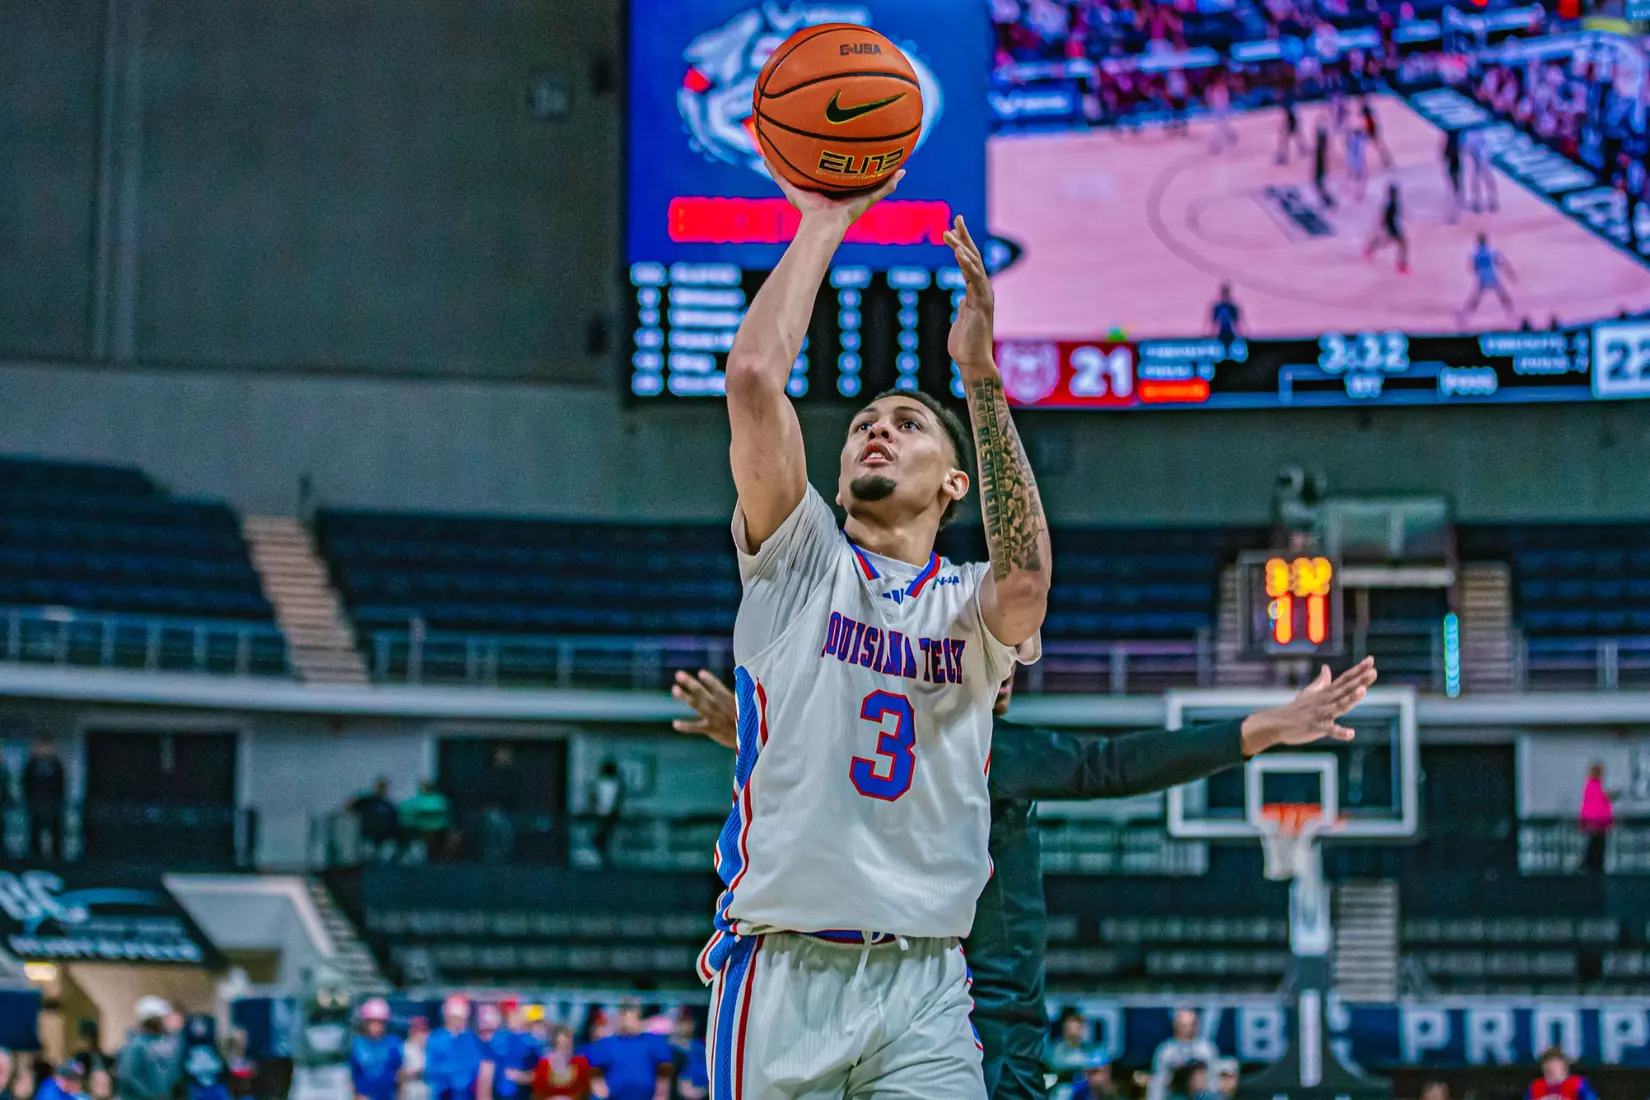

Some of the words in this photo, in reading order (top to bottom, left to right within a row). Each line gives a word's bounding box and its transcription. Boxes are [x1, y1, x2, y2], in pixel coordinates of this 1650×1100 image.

[817, 147, 905, 176] ELITE
[1069, 345, 1134, 398] 21
[821, 610, 918, 679] OUISINA
[849, 689, 916, 802] 3
